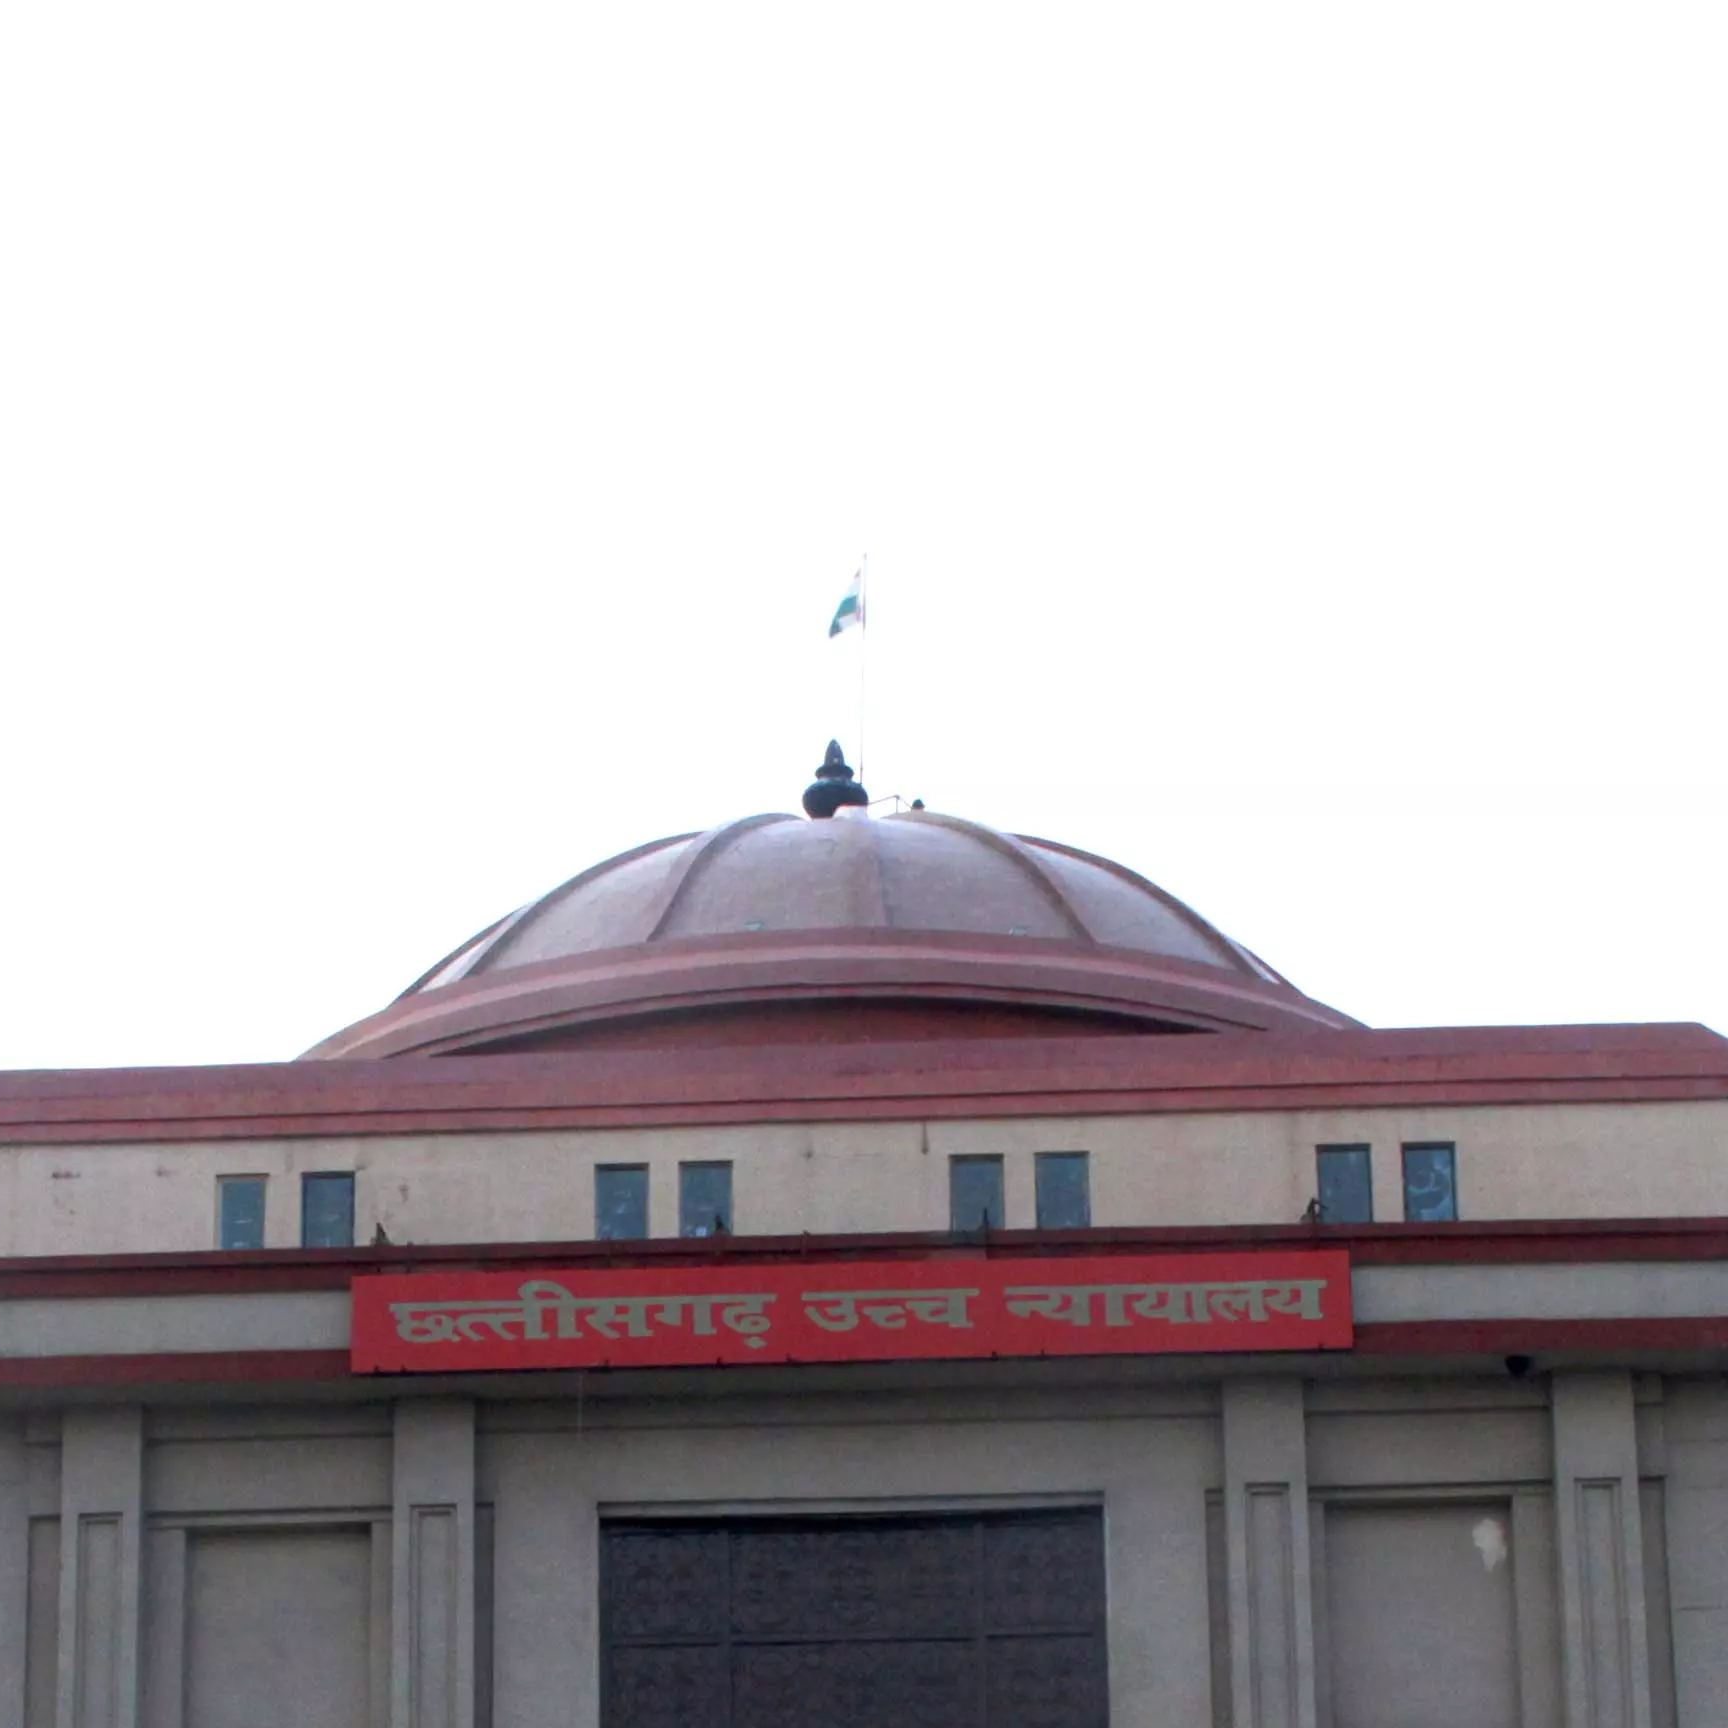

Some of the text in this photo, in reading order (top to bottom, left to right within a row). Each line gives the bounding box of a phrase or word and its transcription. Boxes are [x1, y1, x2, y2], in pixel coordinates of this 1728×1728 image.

[388, 1279, 1328, 1348] छत्तीसगढ़ उच्च न्यायालय
